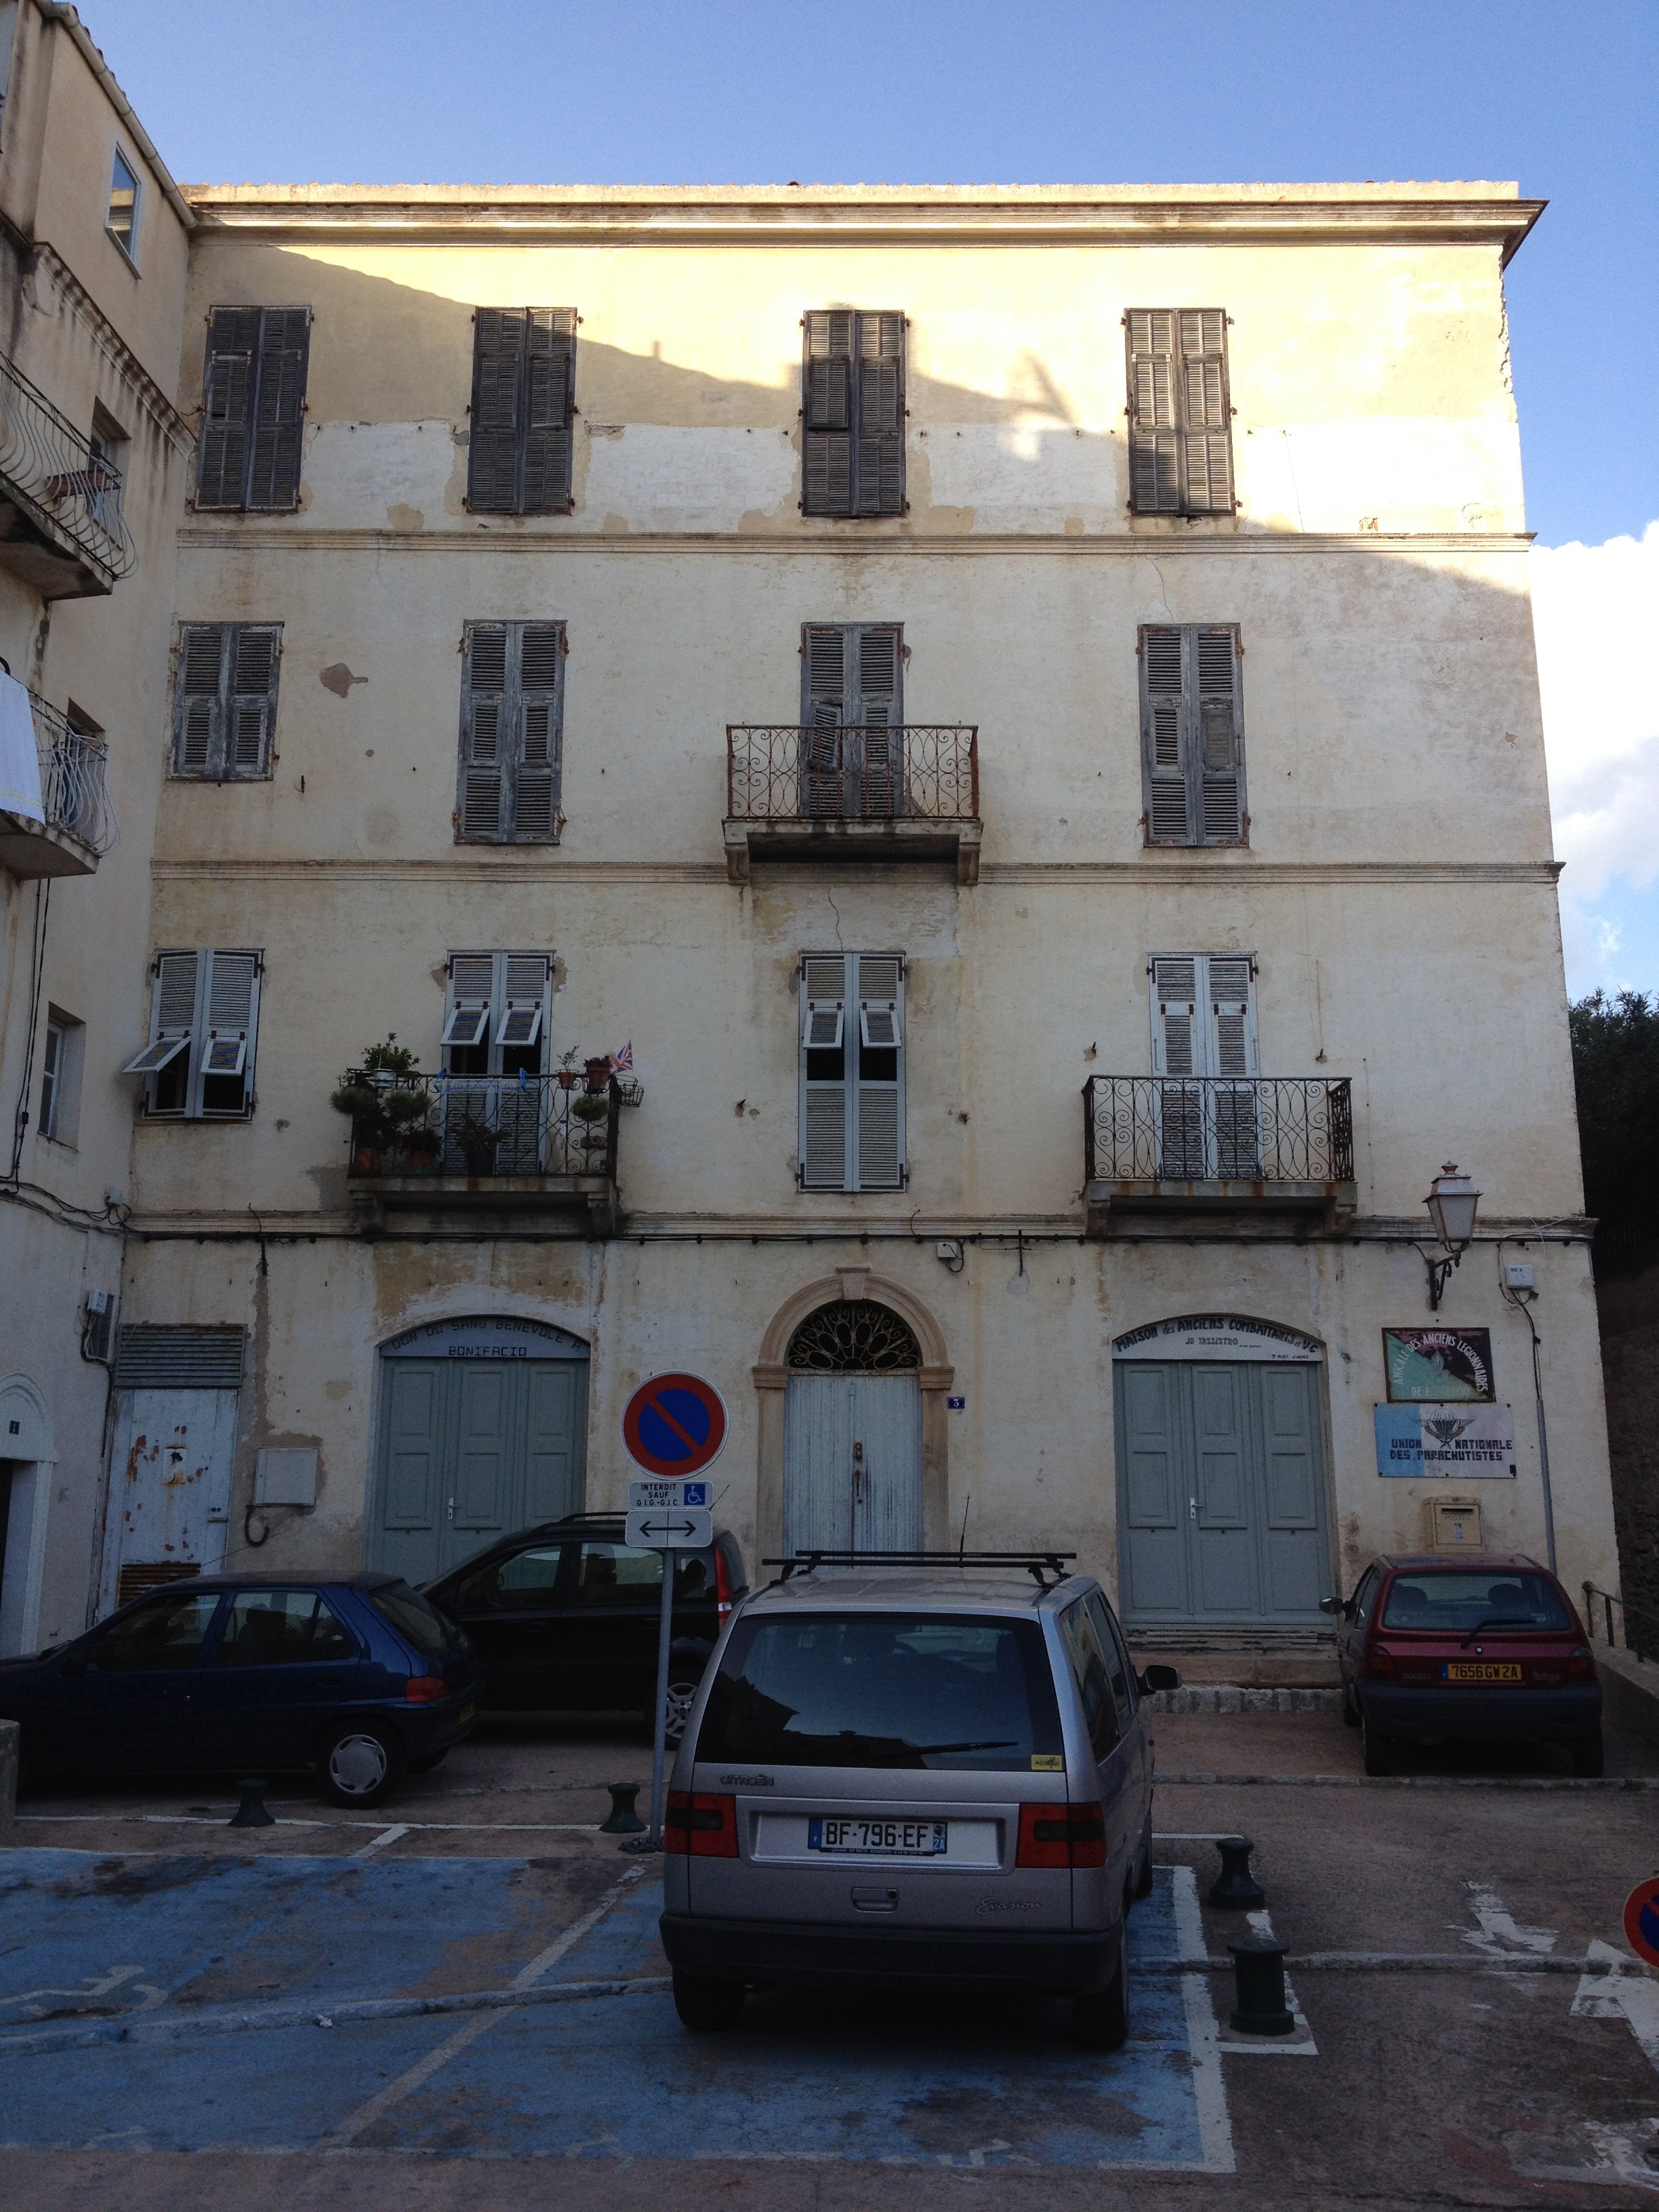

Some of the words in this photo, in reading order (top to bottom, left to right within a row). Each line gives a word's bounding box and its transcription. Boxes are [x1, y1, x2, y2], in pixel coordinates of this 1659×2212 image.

[393, 1332, 417, 1349] DON
[427, 1324, 444, 1336] DU
[452, 1320, 487, 1330] SANG
[496, 1321, 563, 1343] BENEVOLE
[1164, 1324, 1175, 1335] des
[1229, 1319, 1295, 1345] COMBATTANTS
[449, 1347, 527, 1356] BONIFACIO
[1393, 1350, 1410, 1385] AMICALE
[1406, 1338, 1421, 1353] DES
[1423, 1333, 1457, 1347] ANCIENS
[1457, 1340, 1488, 1392] LEGIONNAIRES
[1412, 1387, 1422, 1397] DE
[954, 1399, 960, 1407] 3
[1391, 1439, 1422, 1449] UNION
[1455, 1439, 1513, 1450] NATIONALE
[1391, 1450, 1410, 1460] DES
[1417, 1451, 1502, 1461] PARACHUTISTES
[1452, 1666, 1483, 1678] 7656
[720, 1773, 774, 1786] CITROËN
[934, 1839, 945, 1850] 2A
[976, 1896, 1044, 1915] Evasion
